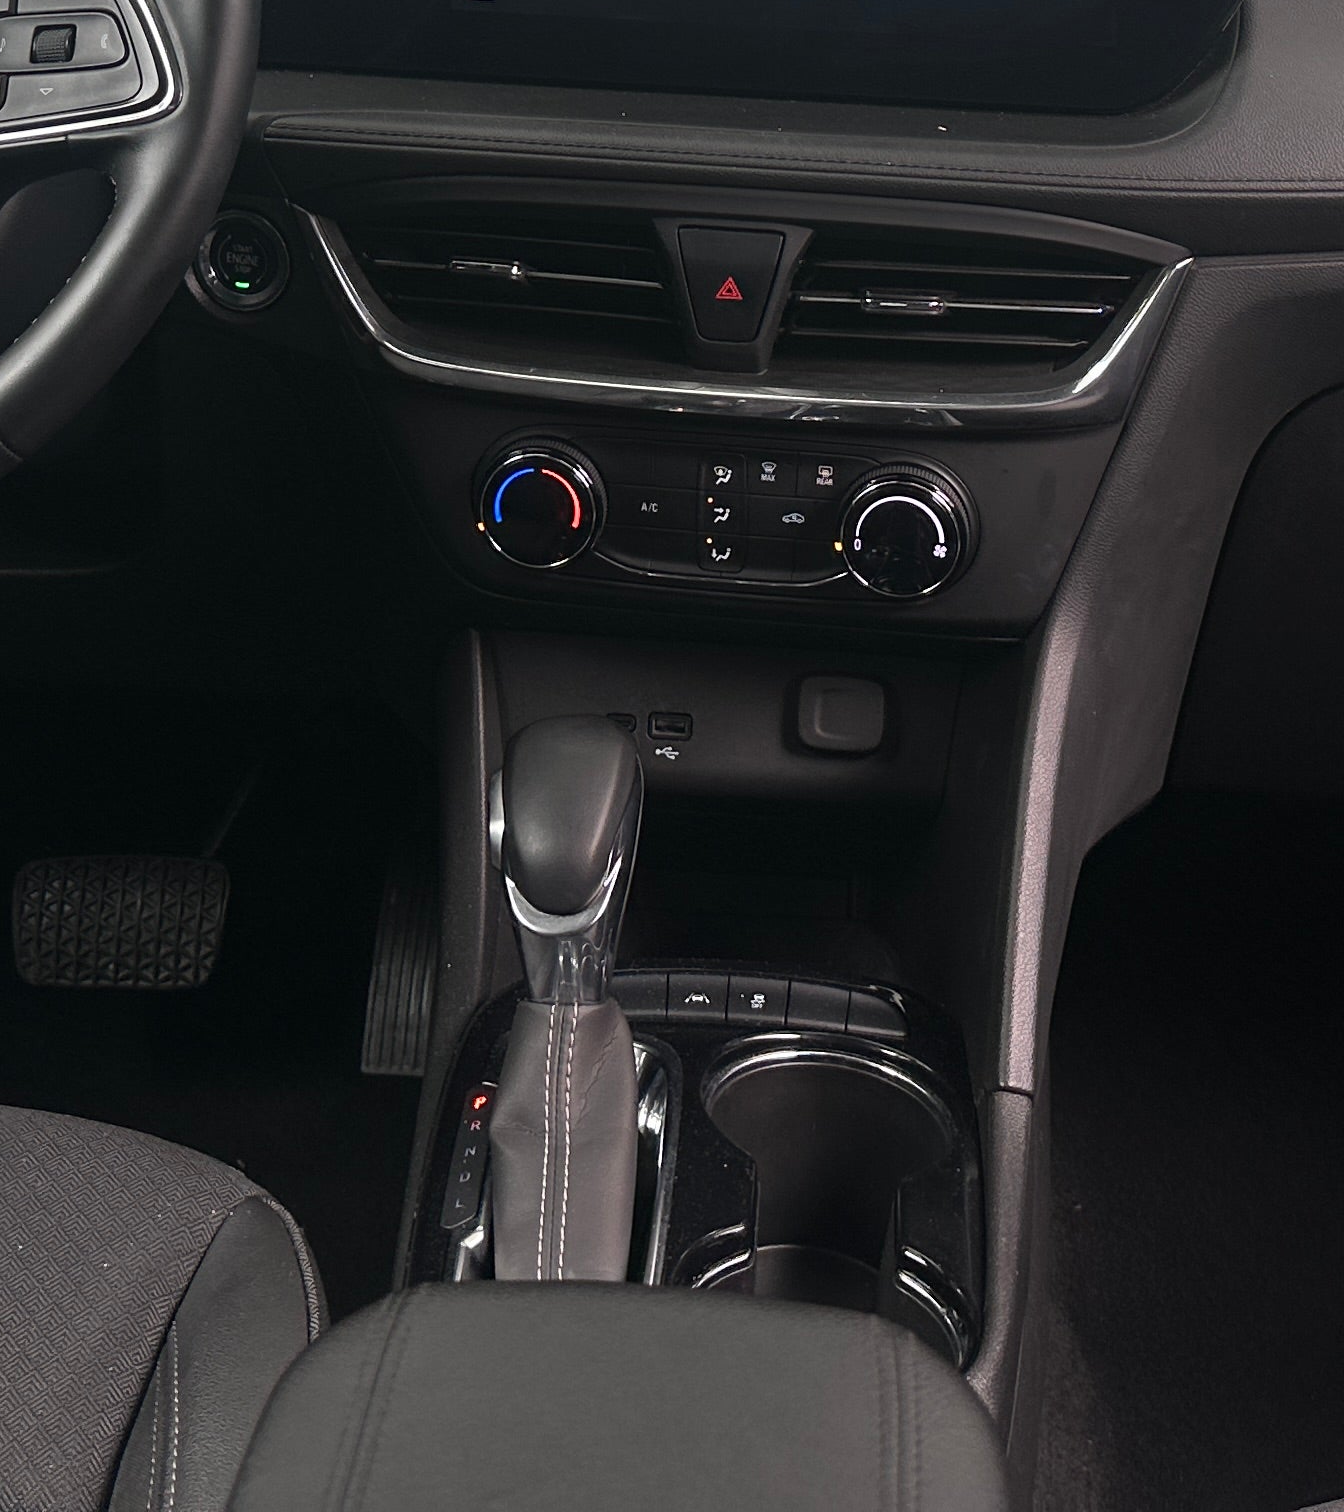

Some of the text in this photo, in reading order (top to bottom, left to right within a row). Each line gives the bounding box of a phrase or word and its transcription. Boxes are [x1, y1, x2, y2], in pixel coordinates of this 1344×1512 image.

[760, 473, 776, 483] MAX
[816, 476, 834, 486] REAR
[641, 501, 659, 513] A/C
[473, 1095, 488, 1110] P
[470, 1120, 481, 1131] R
[464, 1146, 476, 1157] N
